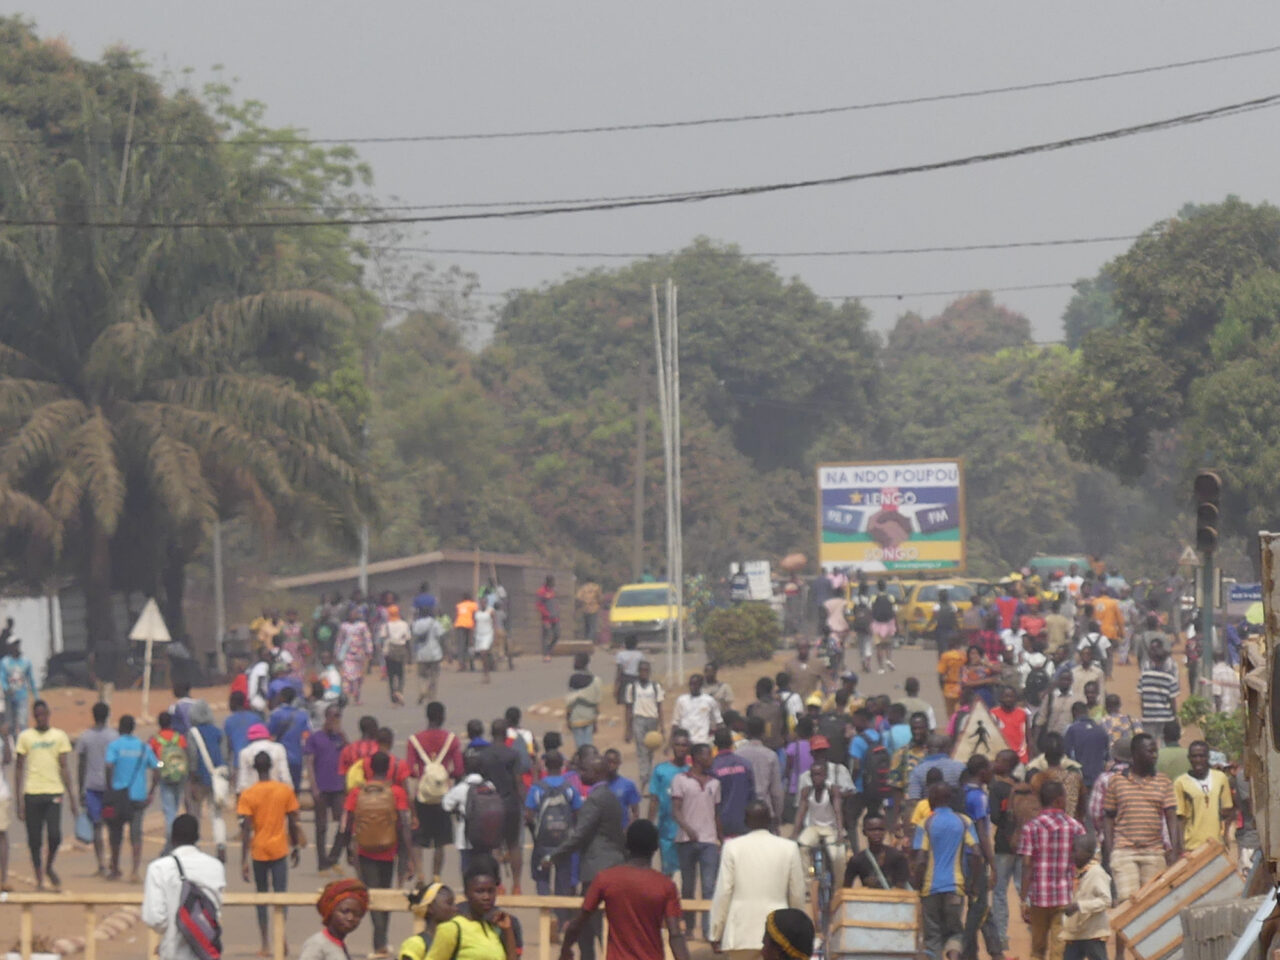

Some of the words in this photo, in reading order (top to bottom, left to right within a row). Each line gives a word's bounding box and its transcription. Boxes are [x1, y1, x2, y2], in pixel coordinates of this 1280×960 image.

[825, 471, 849, 484] NA
[854, 470, 889, 484] NDO
[894, 468, 958, 484] POUPOU
